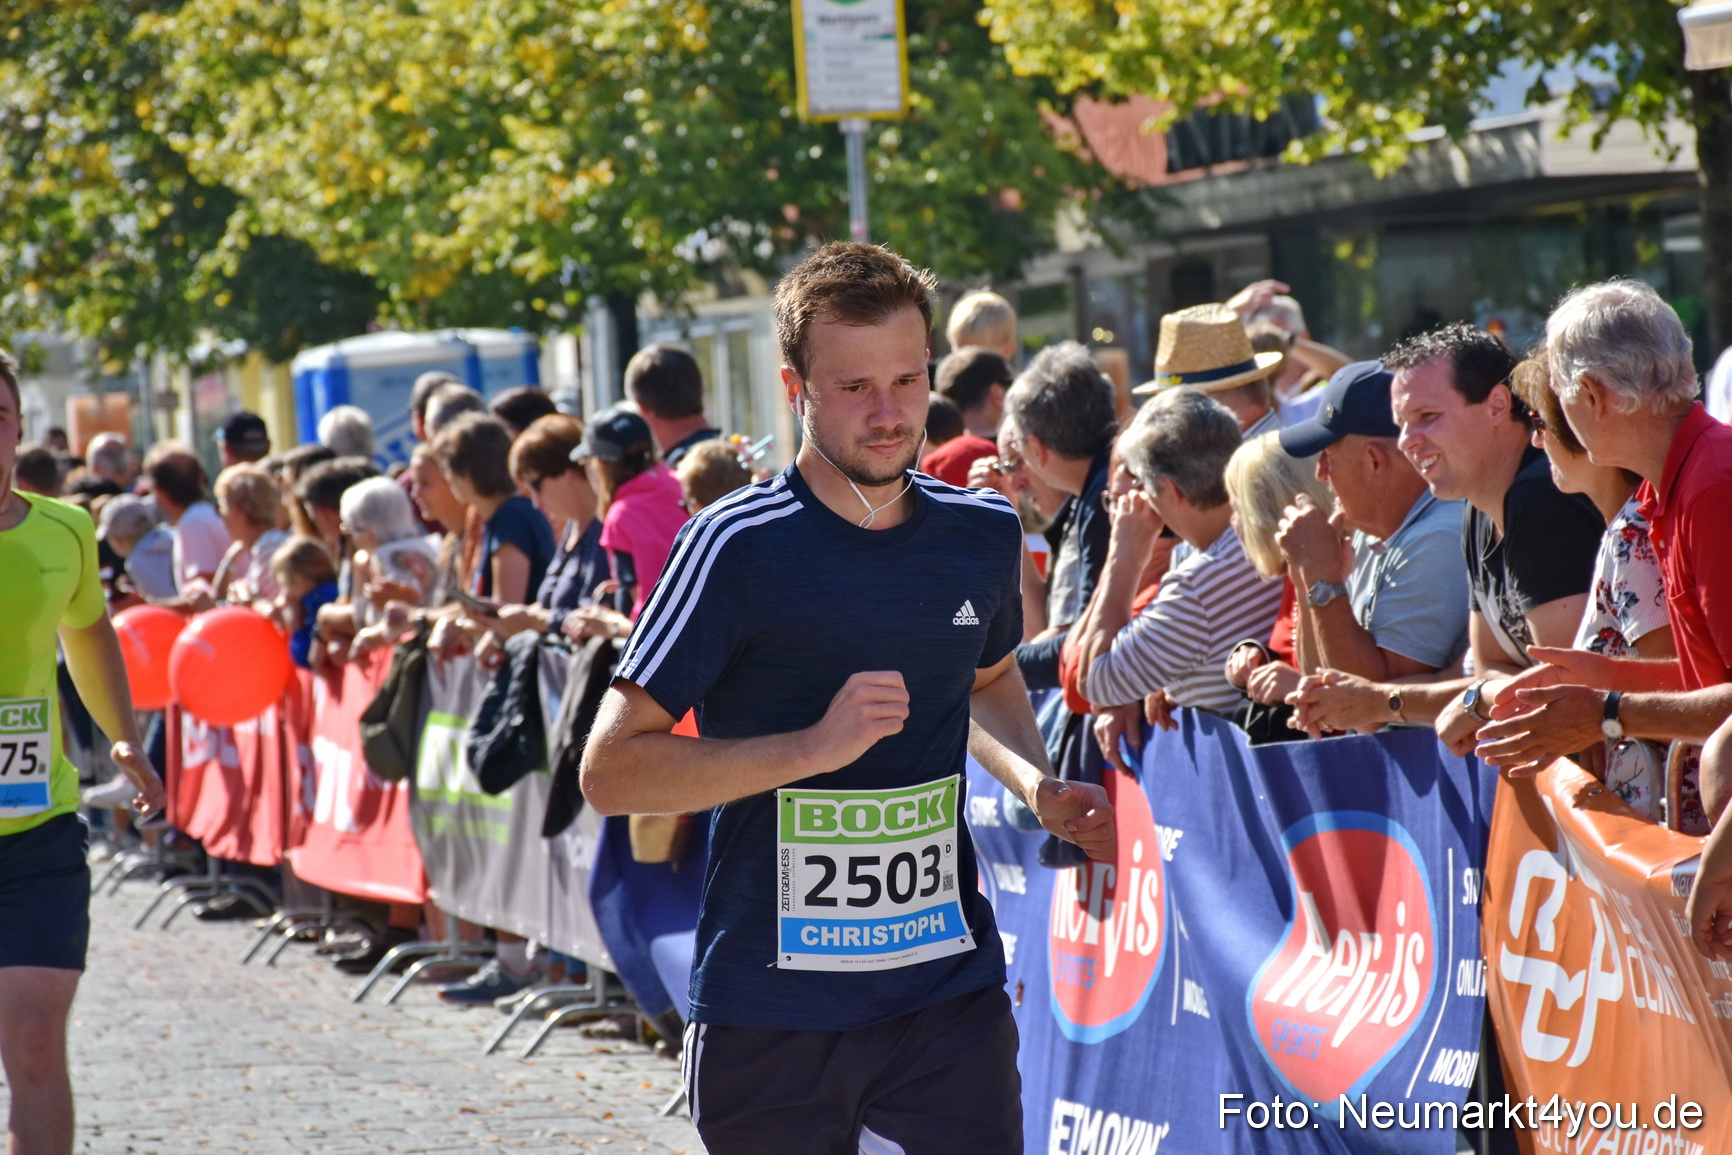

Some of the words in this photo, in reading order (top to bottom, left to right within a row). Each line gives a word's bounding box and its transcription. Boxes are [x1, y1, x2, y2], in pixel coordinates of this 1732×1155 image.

[952, 615, 980, 626] adidas
[0, 741, 39, 776] 75
[795, 786, 947, 838] BOCK
[804, 844, 941, 908] 2503
[800, 912, 946, 947] CHRISTOPH
[1264, 891, 1425, 1048] hervis
